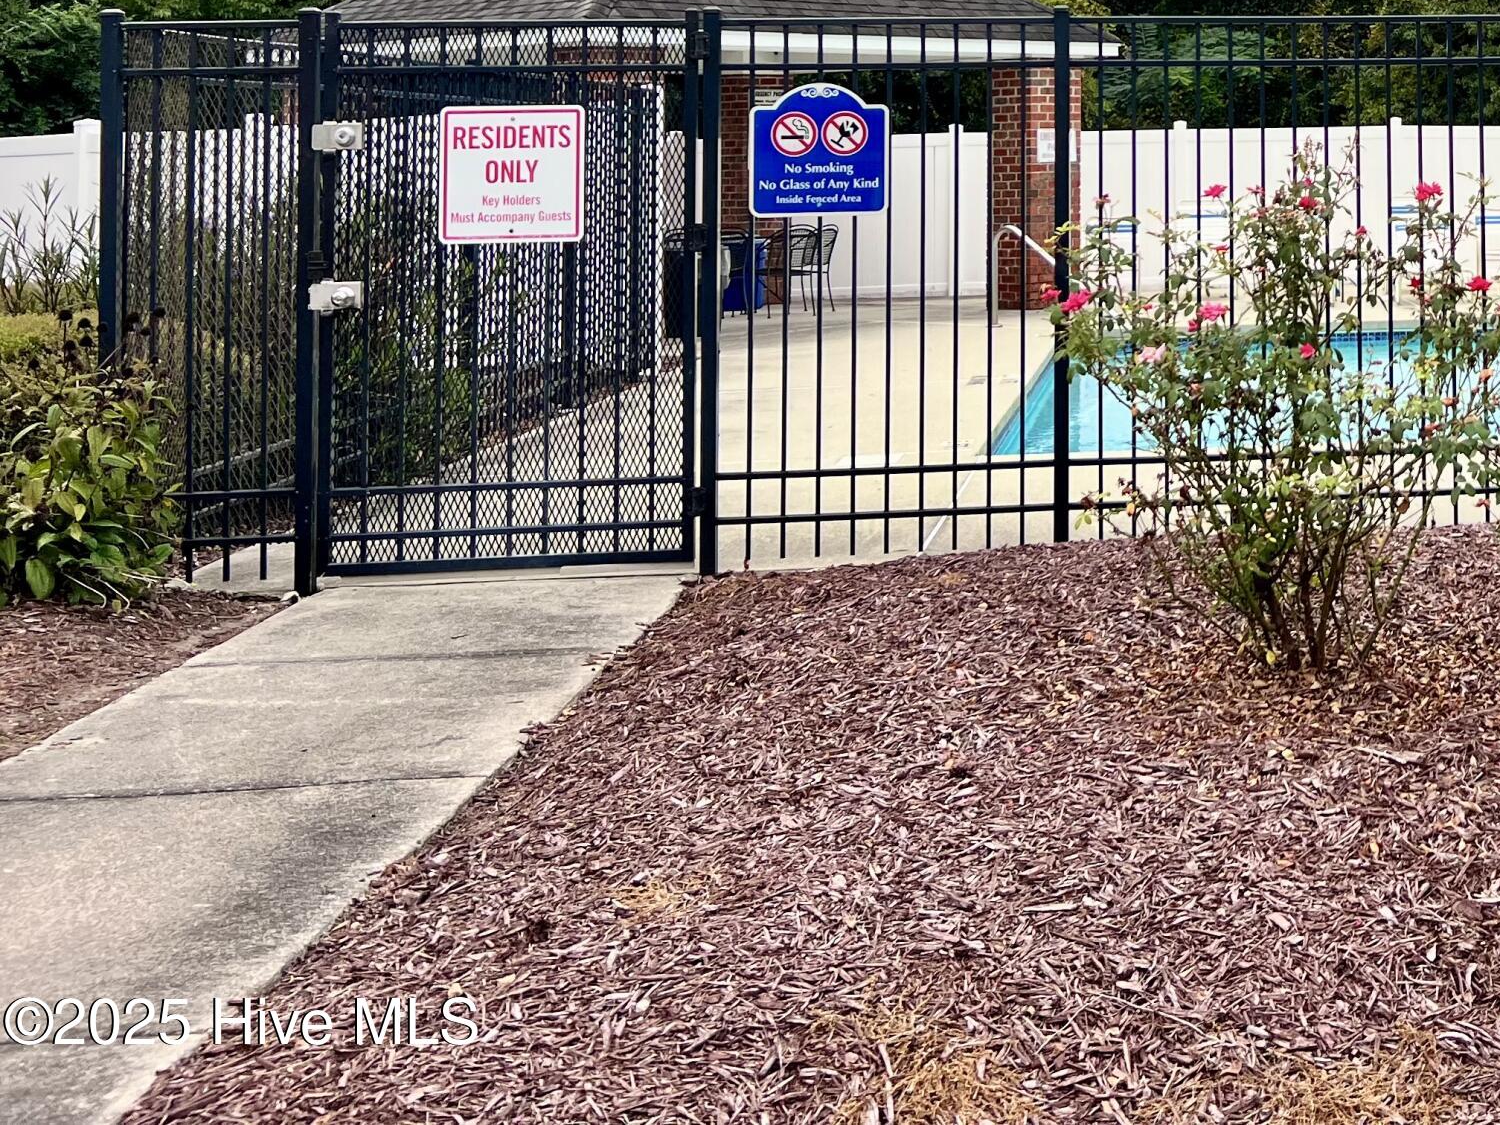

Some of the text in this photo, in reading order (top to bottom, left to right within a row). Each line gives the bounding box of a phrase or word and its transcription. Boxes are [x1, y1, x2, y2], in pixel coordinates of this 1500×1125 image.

[452, 125, 571, 149] RESIDENTS
[485, 160, 539, 183] ONLY
[784, 162, 854, 175] No Smoking
[759, 177, 880, 191] No Glass of Any Kind
[482, 194, 541, 208] Key Holders
[776, 194, 862, 204] Inside Fenced Area
[451, 211, 572, 224] Must Accompany Guests
